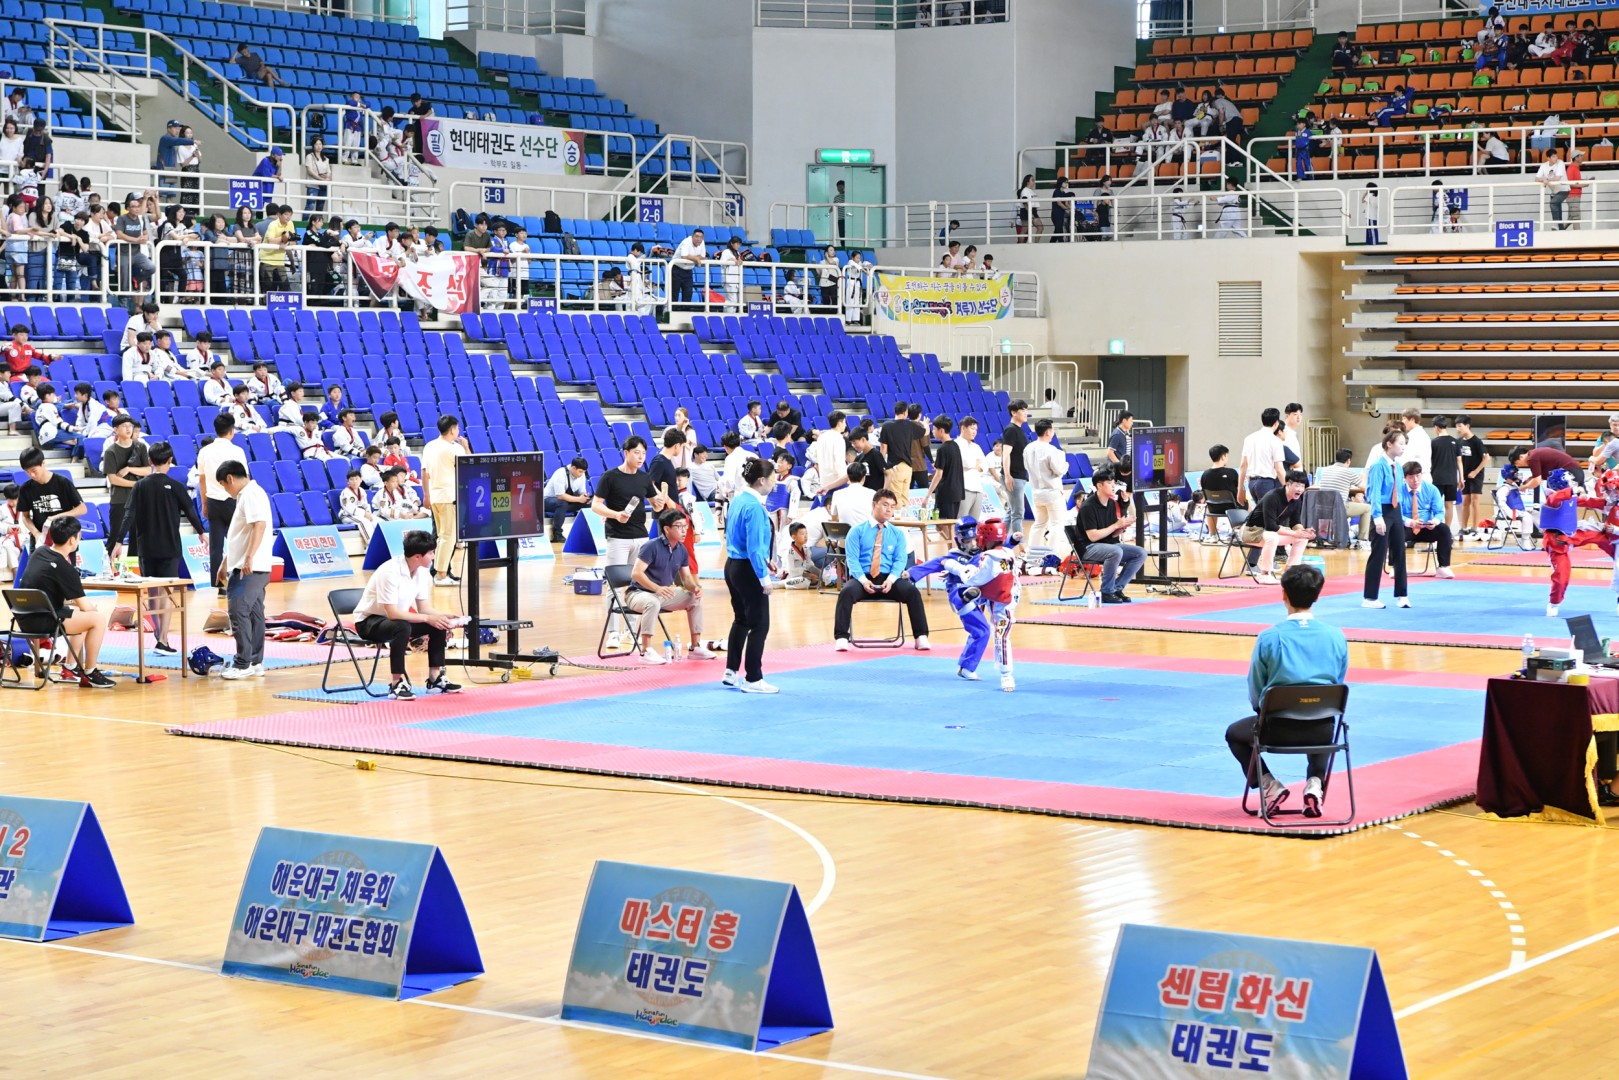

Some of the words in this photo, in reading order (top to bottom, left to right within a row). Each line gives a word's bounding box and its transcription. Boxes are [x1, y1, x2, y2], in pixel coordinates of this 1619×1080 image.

[430, 133, 441, 153] 필
[450, 128, 516, 155] 현대태권도
[520, 135, 558, 158] 선수단
[568, 144, 576, 162] 승
[490, 159, 508, 168] 학부모
[510, 160, 522, 170] 일동
[234, 192, 258, 208] 2-5
[484, 188, 501, 202] 3-6
[643, 208, 660, 222] 2-6
[1502, 232, 1527, 246] 1-8
[270, 294, 286, 302] Block
[955, 301, 977, 316] 겨루기
[978, 298, 998, 314] 선수단
[1144, 450, 1149, 466] 0
[1168, 449, 1174, 464] 0
[476, 486, 485, 508] 2
[493, 497, 509, 508] 0:29
[517, 484, 526, 504] 7
[294, 538, 319, 549] 해운대
[320, 537, 336, 548] 현대
[310, 552, 334, 564] 태권도
[9, 828, 30, 856] 2
[272, 862, 340, 900] 해운대구
[340, 870, 395, 908] 체육회
[244, 905, 311, 945] 해운대구
[313, 915, 398, 958] 태권도협회
[621, 900, 703, 945] 마스터
[707, 912, 740, 950] 홍
[626, 952, 708, 998] 태권도
[1160, 966, 1230, 1010] 센텀
[1236, 974, 1310, 1020] 화신
[1171, 1023, 1273, 1072] 태권도
